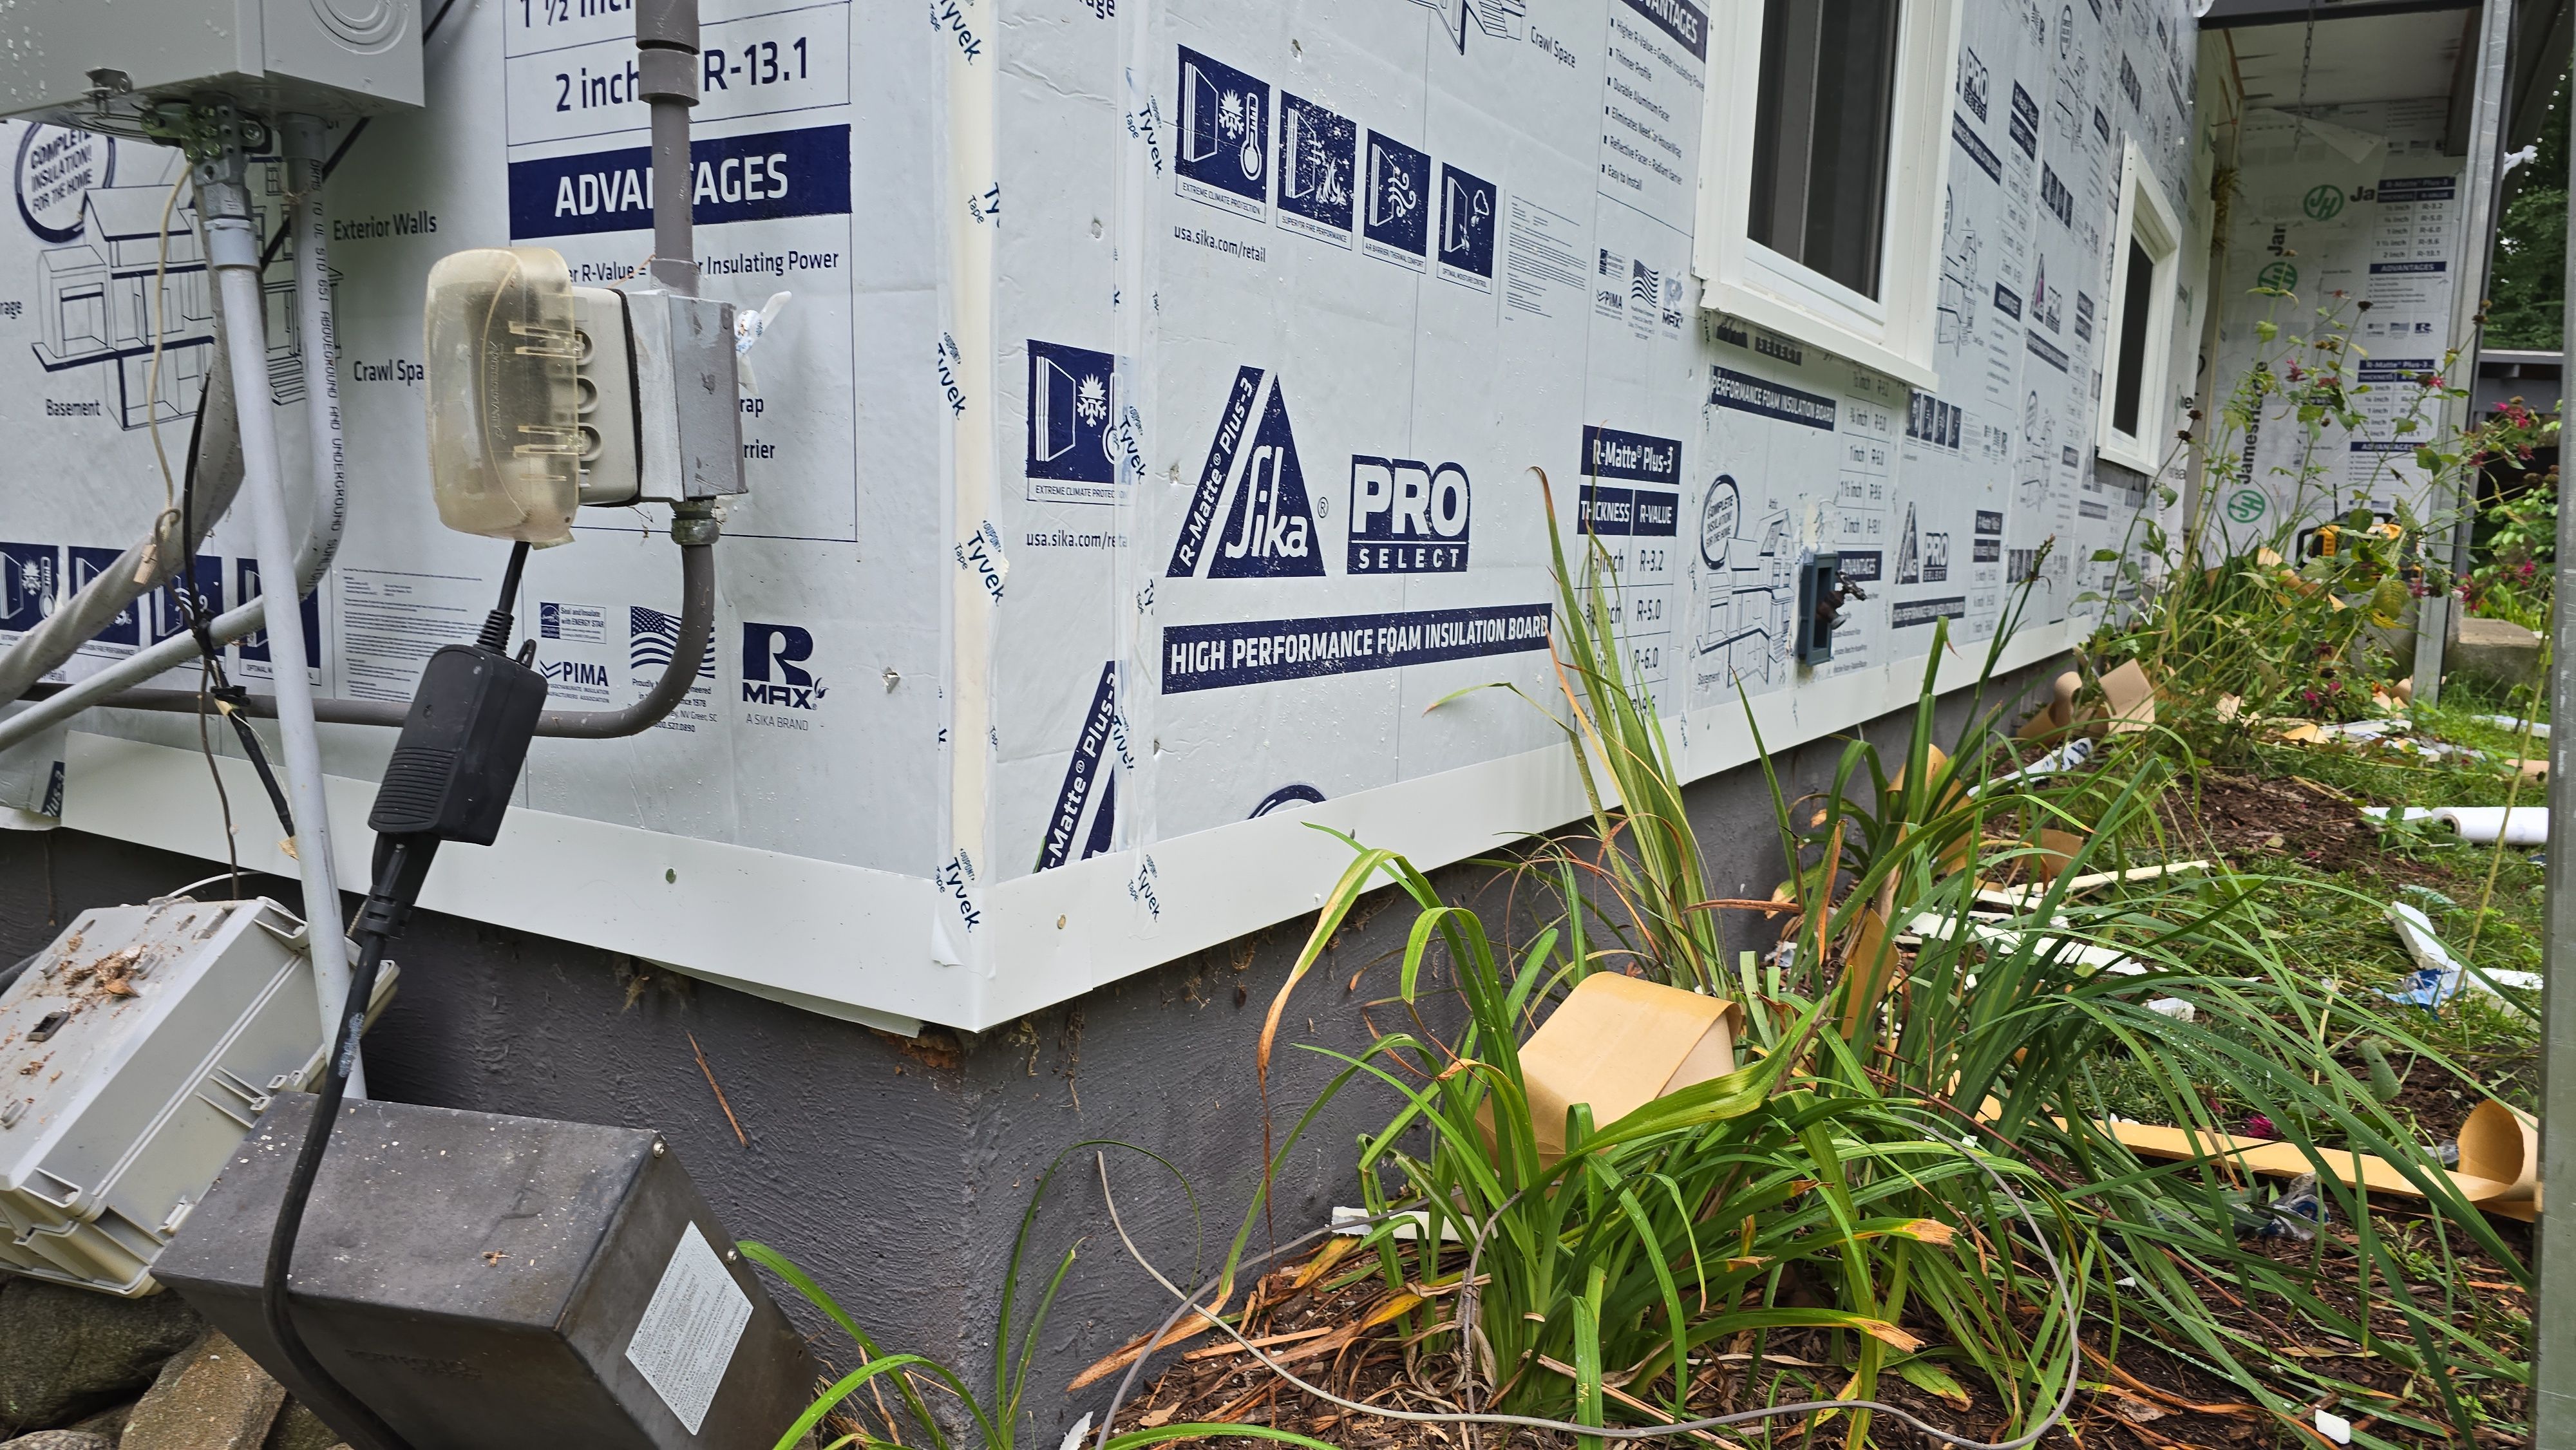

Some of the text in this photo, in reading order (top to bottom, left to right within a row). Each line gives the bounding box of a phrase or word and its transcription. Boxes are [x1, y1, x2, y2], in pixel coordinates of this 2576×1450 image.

[1531, 25, 1576, 69] Crawl Space
[555, 73, 572, 112] 2
[703, 36, 808, 92] R-13.1
[1126, 111, 1139, 139] Tape
[1139, 102, 1162, 178] Tyvek
[31, 129, 93, 169] COMPLET
[554, 153, 788, 218] ADVAAGES
[967, 194, 985, 225] Tape
[333, 210, 437, 241] Exterior Walls
[1173, 225, 1266, 263] usa.sika.com/retail
[582, 261, 634, 282] R-Value
[707, 254, 784, 278] Insulating
[788, 250, 839, 271] Power
[354, 359, 424, 386] Crawl Spa
[45, 398, 101, 417] Basement
[1219, 376, 1253, 455] Plus-3
[744, 439, 775, 459] rrier
[1643, 446, 1674, 474] Plus-3
[1036, 485, 1092, 498] EXTREME CLIMATE
[1224, 445, 1309, 559] Sika
[1352, 464, 1466, 537] PRO
[1580, 500, 1672, 525] THICKNESS R-VALUE
[954, 542, 969, 570] Tape
[1358, 547, 1460, 570] SELECT
[1640, 549, 1664, 572] R-3.2
[1925, 533, 1949, 567] PRO
[967, 529, 1005, 607] Tyvek
[1636, 599, 1662, 622] R-5.0
[743, 621, 814, 688] R
[1170, 614, 1549, 675] HIGH PERFORMANCE FOAM INSULATION BOARD
[1633, 646, 1659, 670] R-6.0
[562, 661, 610, 687] PIMA
[746, 713, 810, 731] A SIKA BRAND
[945, 856, 981, 932] Tyvek
[1137, 863, 1160, 921] Tyvek
